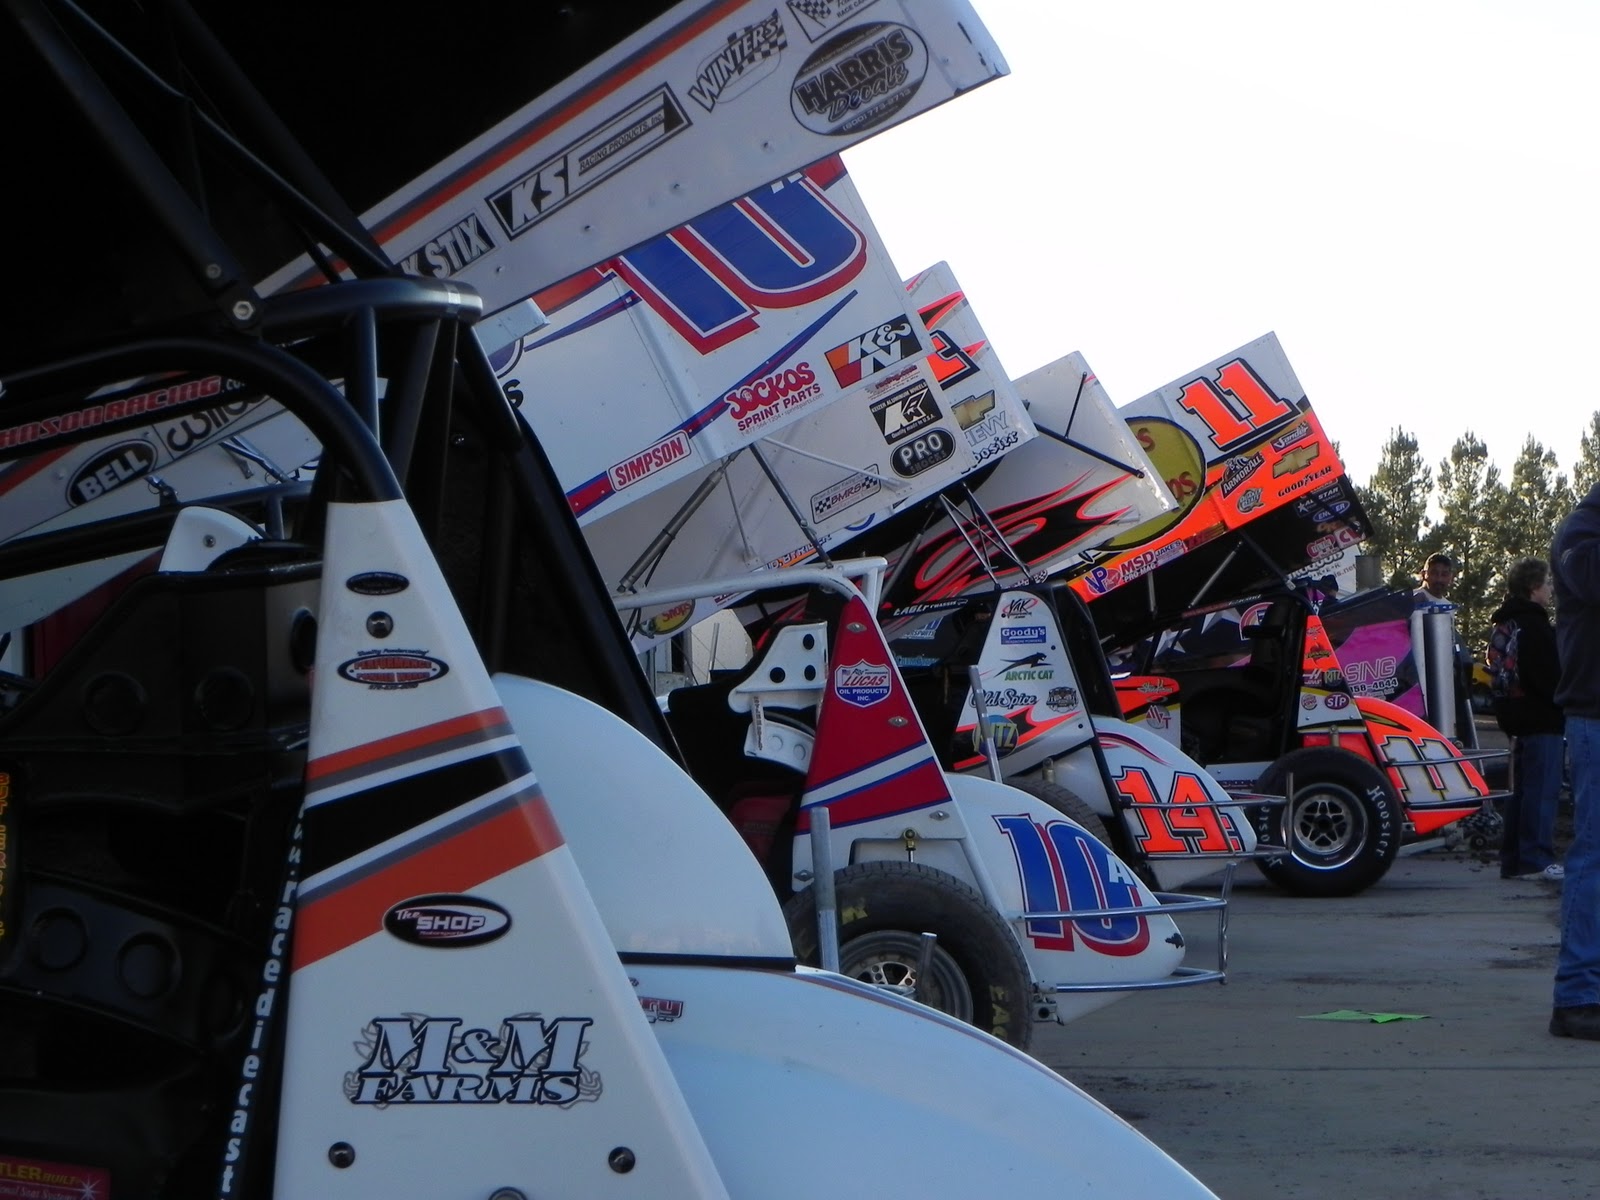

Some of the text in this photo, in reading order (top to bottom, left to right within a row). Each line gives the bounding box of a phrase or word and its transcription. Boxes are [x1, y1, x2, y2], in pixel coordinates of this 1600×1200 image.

[687, 17, 779, 113] WINTERS
[795, 29, 913, 115] HARRIS
[580, 149, 608, 170] RACING
[848, 322, 912, 380] K&N
[724, 361, 816, 420] JOCKOS
[784, 392, 825, 415] sprintparts.com
[1176, 357, 1302, 452] 11
[736, 383, 822, 432] SPRINT PARTS
[614, 437, 684, 486] SIMPSON
[899, 433, 942, 467] PRO
[909, 450, 946, 475] SHOCKS
[76, 449, 149, 502] BELL
[831, 483, 862, 506] BMRS
[1318, 487, 1339, 500] STAR
[1119, 551, 1155, 577] MSD
[1084, 566, 1108, 593] VP
[1002, 628, 1045, 640] Goody's
[842, 675, 887, 686] LUCAS
[1004, 669, 1055, 681] ARCTIC CAT
[1324, 671, 1342, 684] RITZ
[1344, 656, 1396, 684] SING
[999, 688, 1038, 709] Spice
[1327, 694, 1347, 707] STP
[1380, 736, 1483, 812] 11
[1112, 765, 1246, 854] 14
[1366, 785, 1391, 857] Hoosier
[991, 813, 1150, 957] 10 A
[395, 909, 421, 921] The
[415, 915, 486, 931] SHOP
[358, 1017, 594, 1077] M&M
[351, 1073, 583, 1106] FARMS
